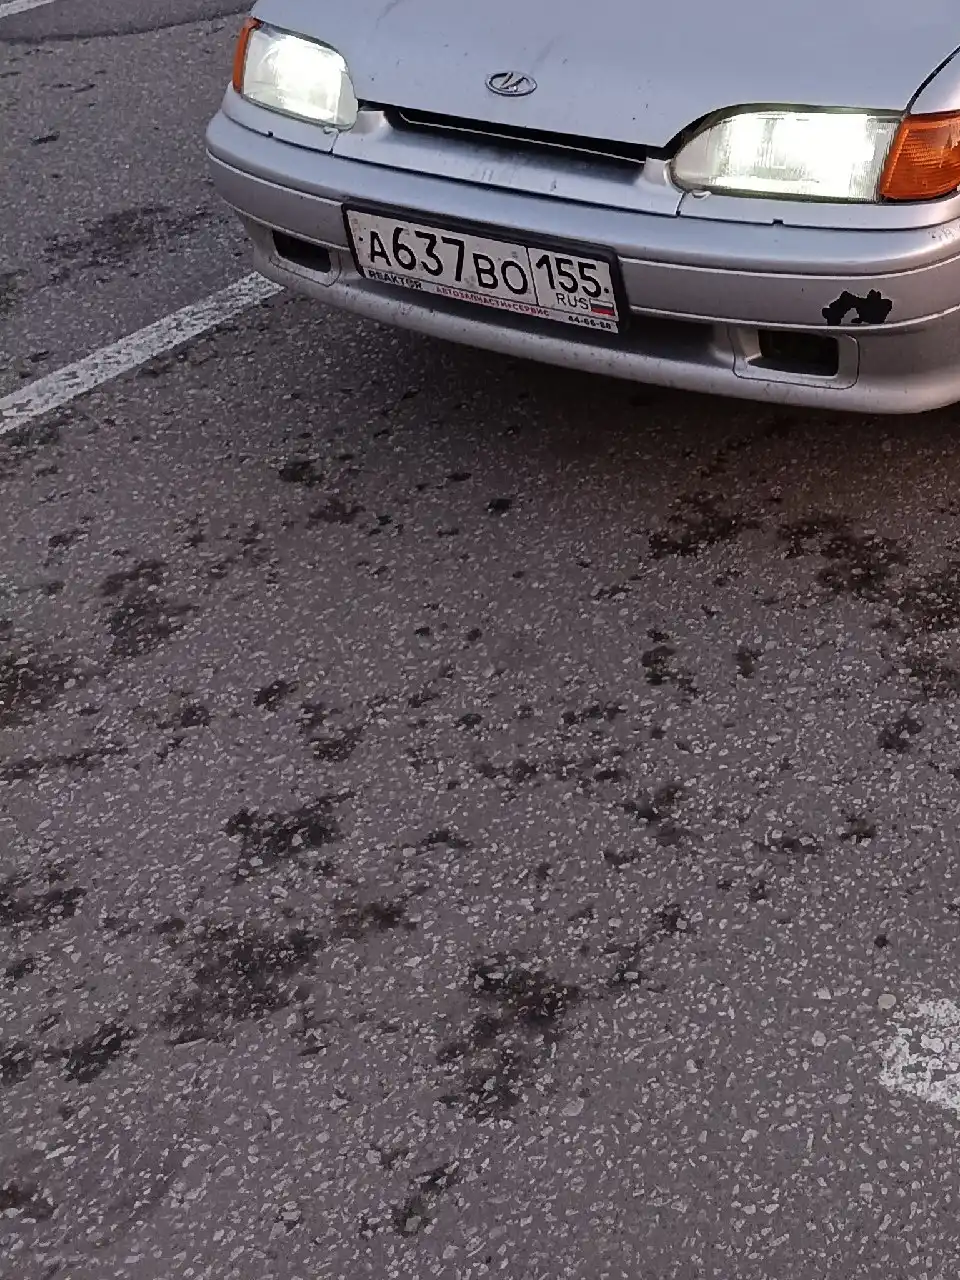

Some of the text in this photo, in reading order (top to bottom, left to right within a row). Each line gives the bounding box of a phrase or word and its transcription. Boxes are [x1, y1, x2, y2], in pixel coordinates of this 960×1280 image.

[370, 227, 602, 298] А637ВО 155
[556, 292, 589, 310] RUS
